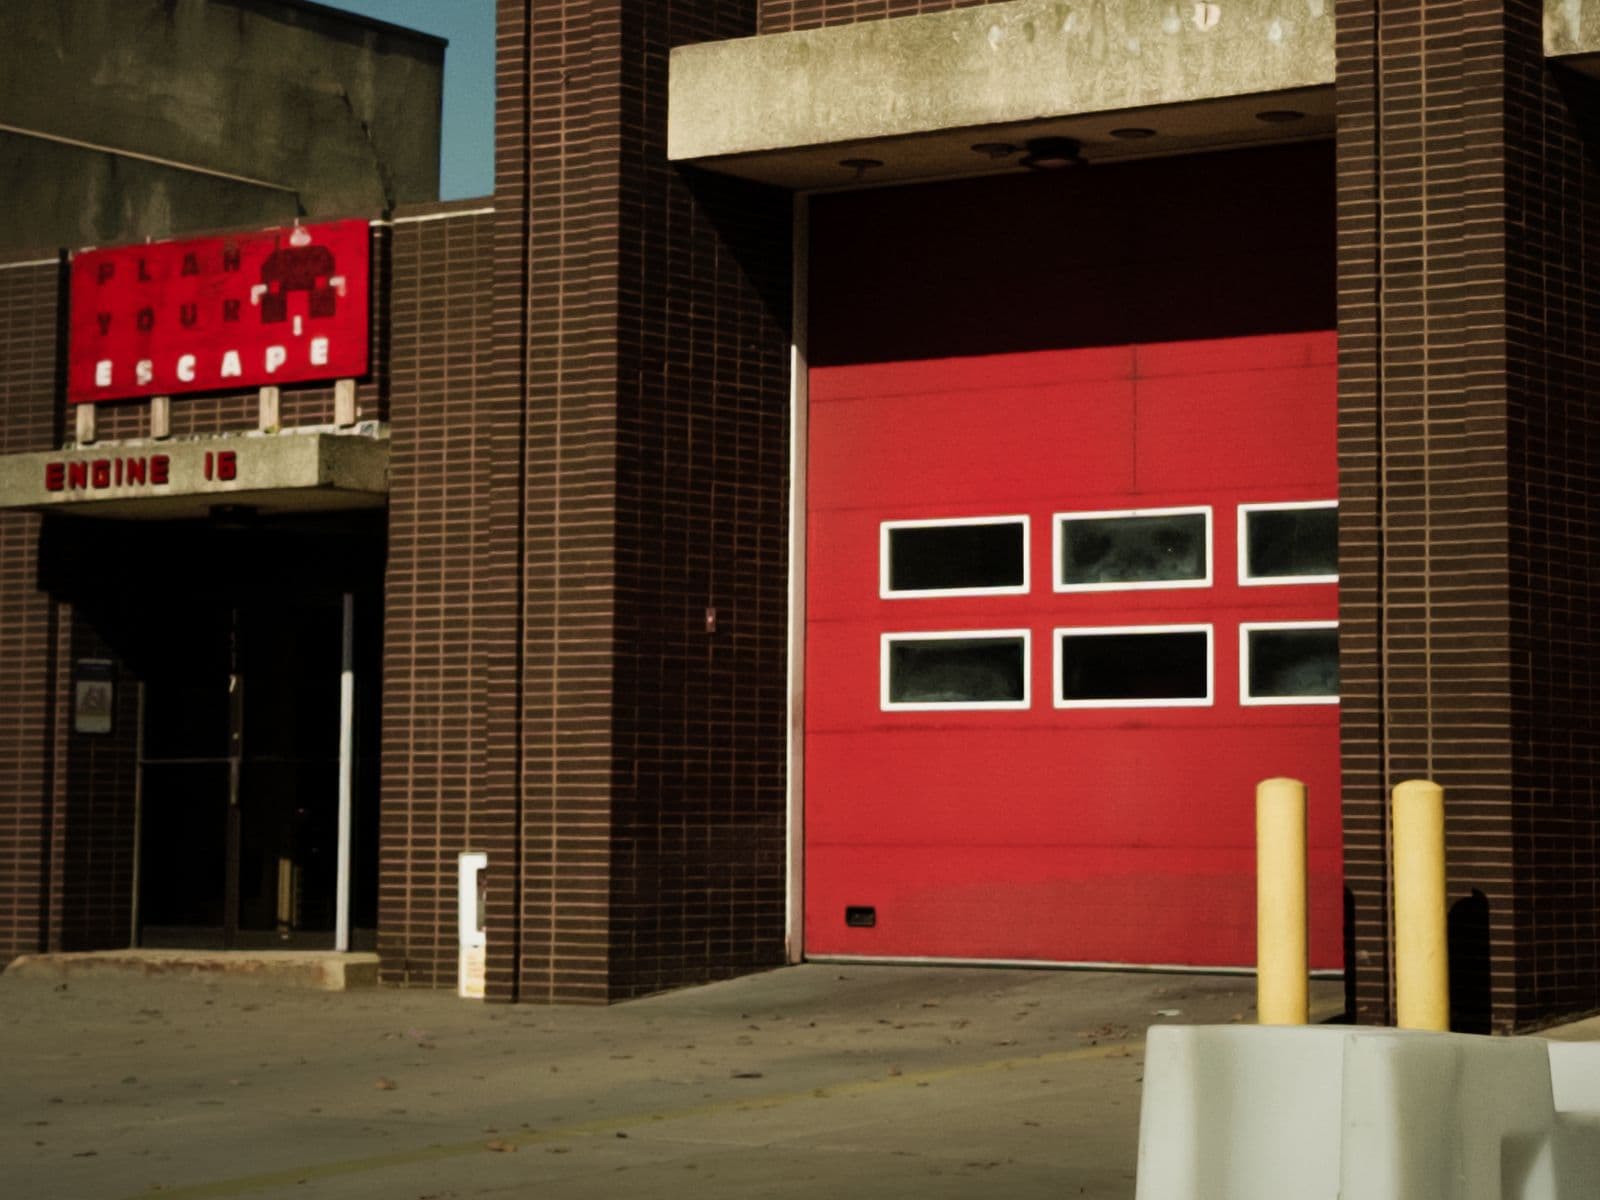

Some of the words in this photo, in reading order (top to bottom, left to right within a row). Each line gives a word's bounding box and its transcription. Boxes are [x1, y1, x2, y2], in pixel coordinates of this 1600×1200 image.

[97, 249, 241, 285] PLAN
[96, 299, 241, 337] YOUR
[95, 337, 329, 387] ESCAPE
[45, 454, 170, 492] ENGINE
[204, 450, 238, 481] 16
